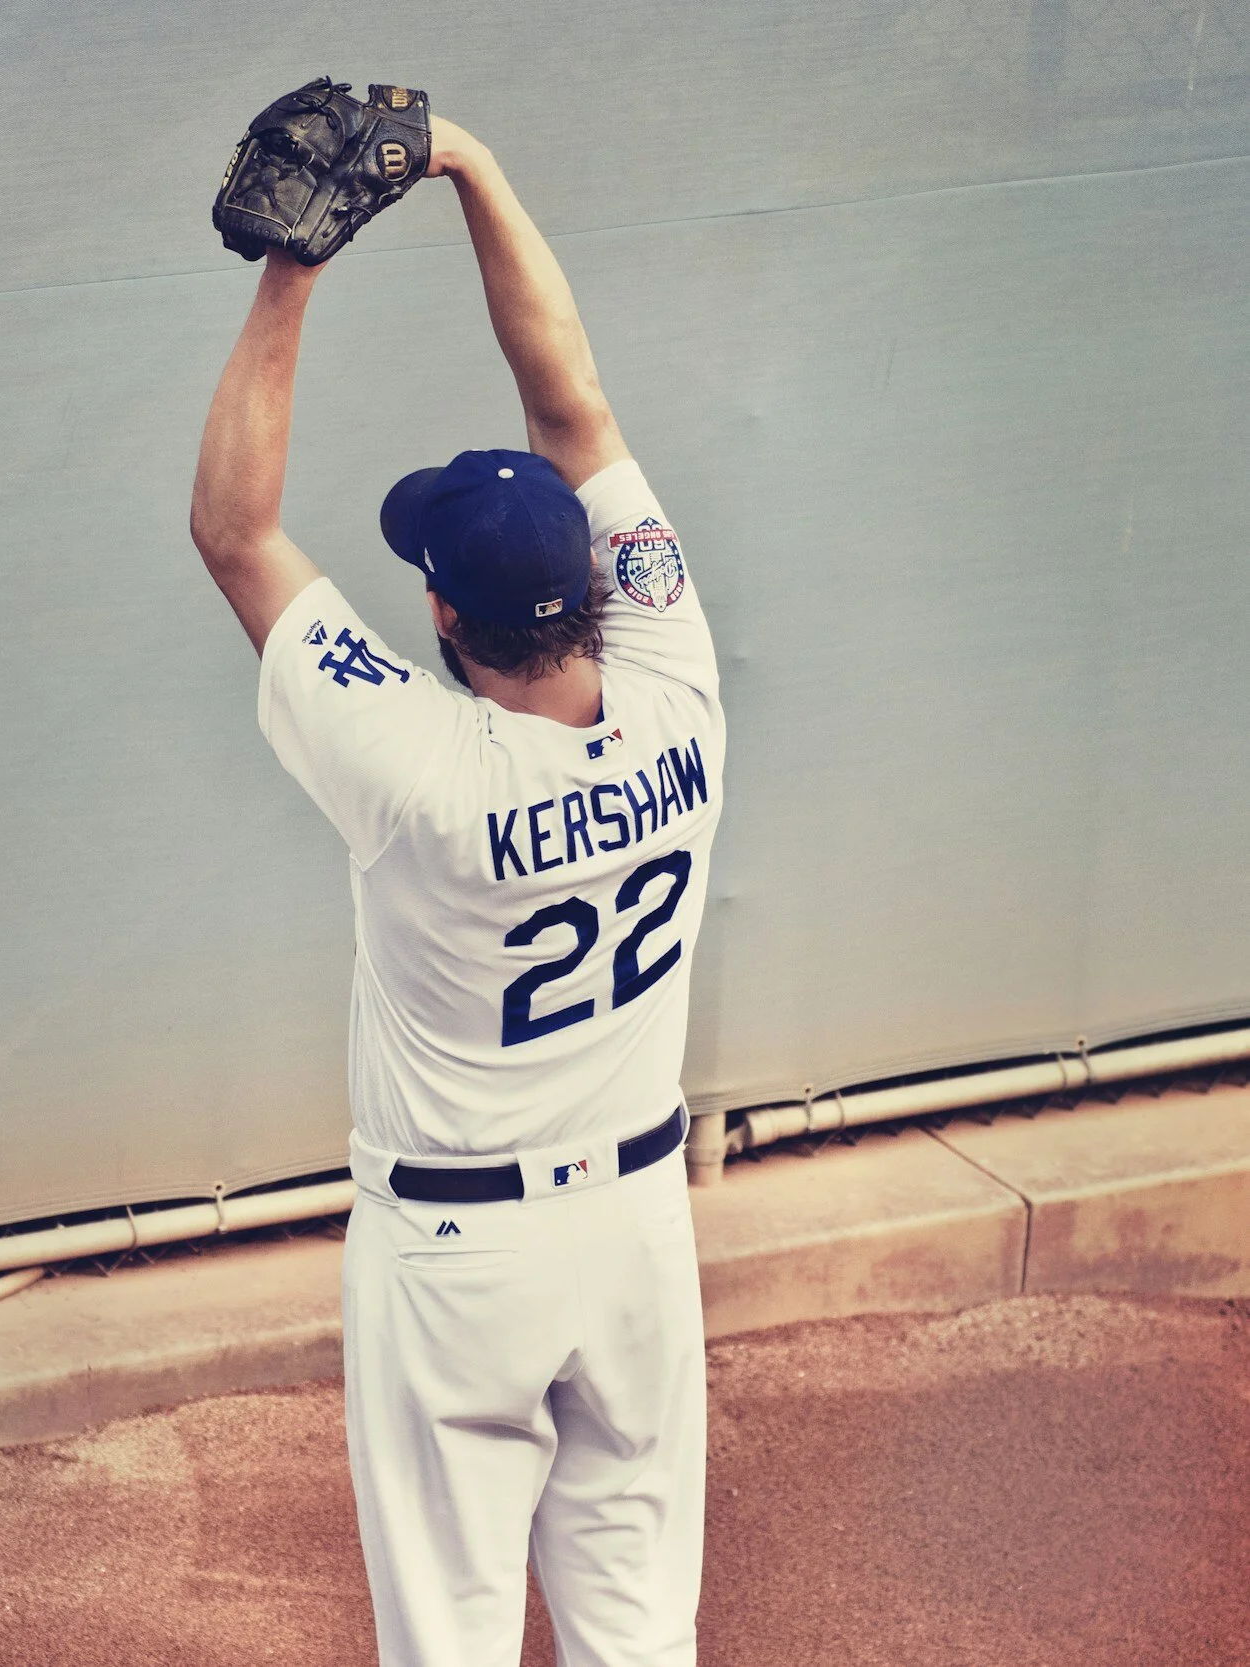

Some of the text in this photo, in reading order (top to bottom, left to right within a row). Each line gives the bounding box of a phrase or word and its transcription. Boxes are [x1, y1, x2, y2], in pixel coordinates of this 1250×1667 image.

[618, 531, 661, 542] ANGELES
[627, 586, 649, 604] 2018
[301, 619, 322, 645] Majestic
[318, 627, 410, 688] LA
[487, 737, 708, 881] KERSHAW
[501, 850, 692, 1047] 22
